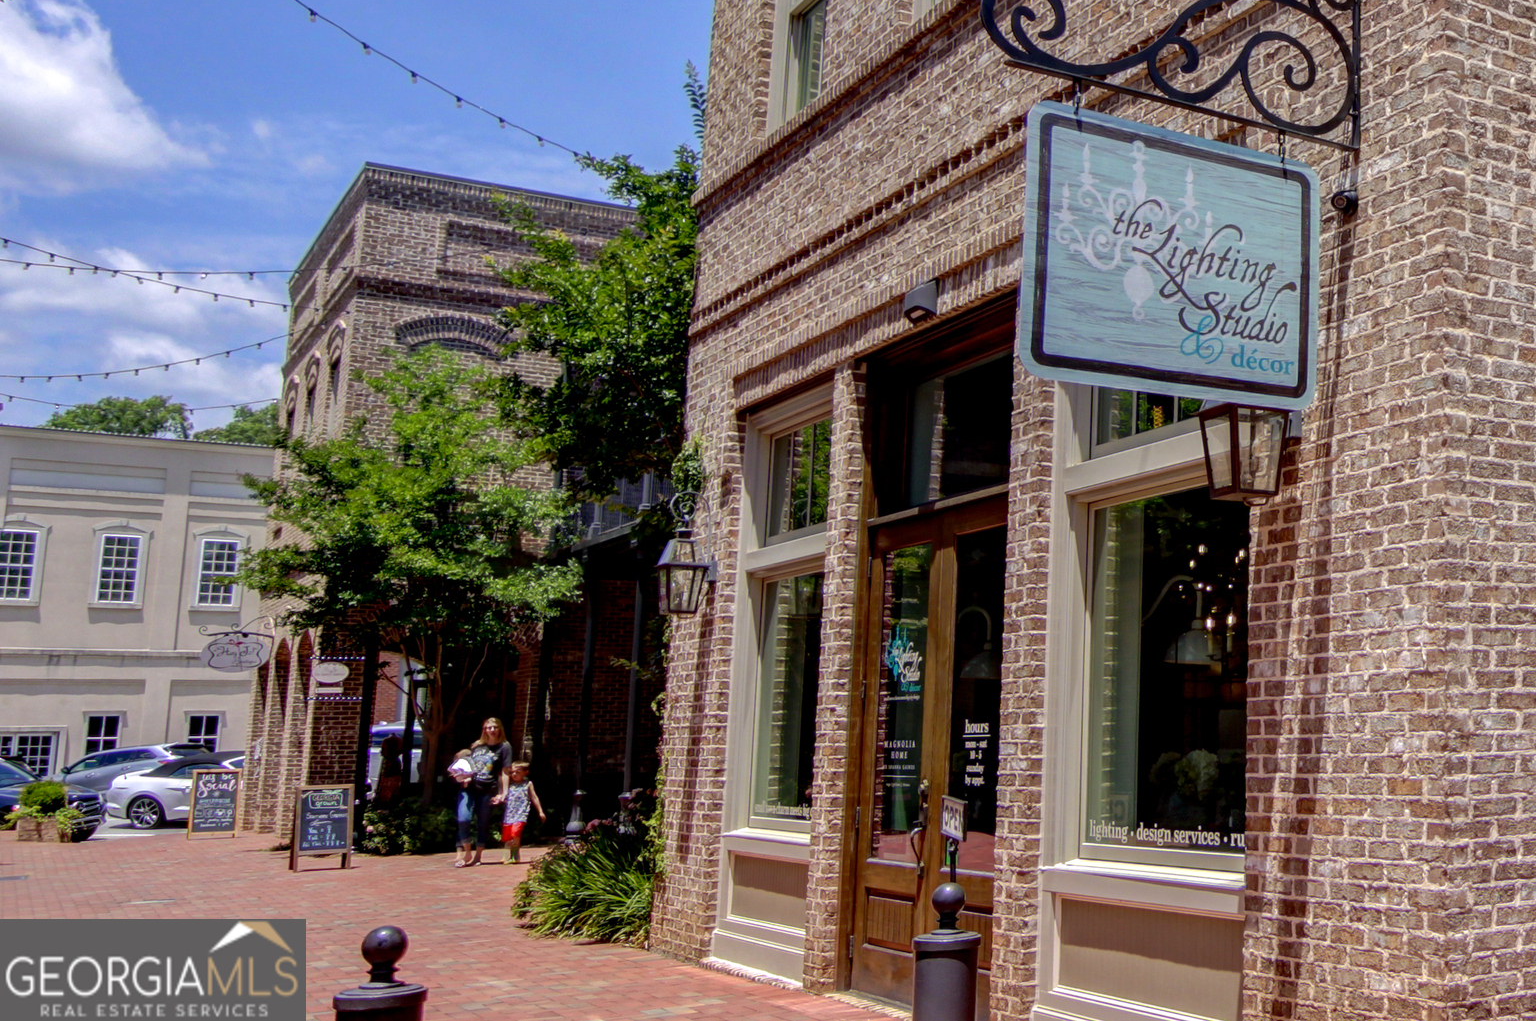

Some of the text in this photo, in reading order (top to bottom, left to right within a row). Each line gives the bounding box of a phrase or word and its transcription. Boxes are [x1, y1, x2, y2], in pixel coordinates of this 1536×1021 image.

[1111, 199, 1163, 240] the
[1132, 224, 1278, 312] Lighting
[1178, 281, 1298, 345] Studio
[1230, 344, 1295, 376] décor
[964, 719, 989, 733] hours
[883, 740, 916, 748] MAGNOLIA
[890, 751, 908, 759] HOME
[196, 779, 237, 798] Social
[944, 803, 964, 834] OPEN
[1089, 818, 1129, 843] lighting
[1136, 822, 1172, 846] design
[1173, 825, 1221, 847] services
